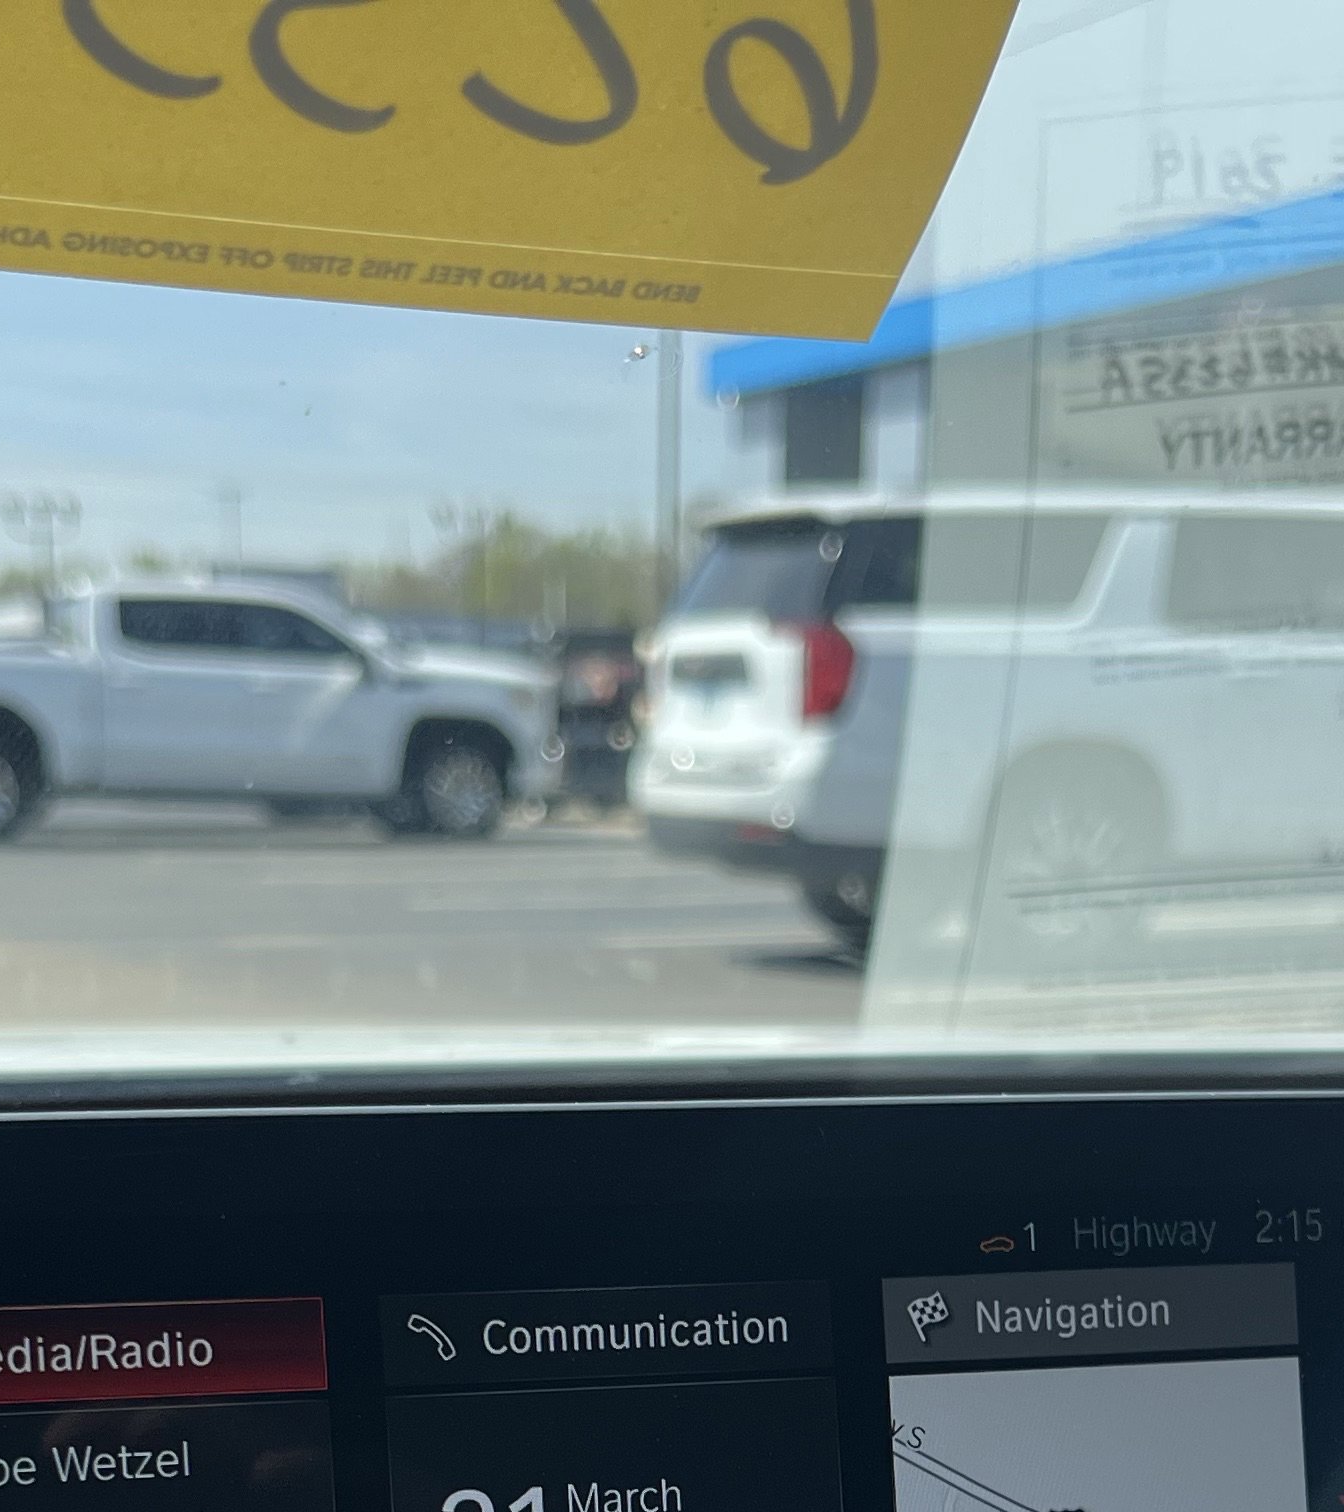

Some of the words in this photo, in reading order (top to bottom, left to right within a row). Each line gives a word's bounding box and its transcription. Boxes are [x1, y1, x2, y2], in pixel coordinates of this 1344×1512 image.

[1023, 1221, 1037, 1252] 1
[1073, 1215, 1216, 1257] Highway
[1255, 1207, 1324, 1244] 2:15
[482, 1310, 790, 1356] Communication
[975, 1294, 1171, 1339] Navigation
[52, 1441, 193, 1485] Wetzel
